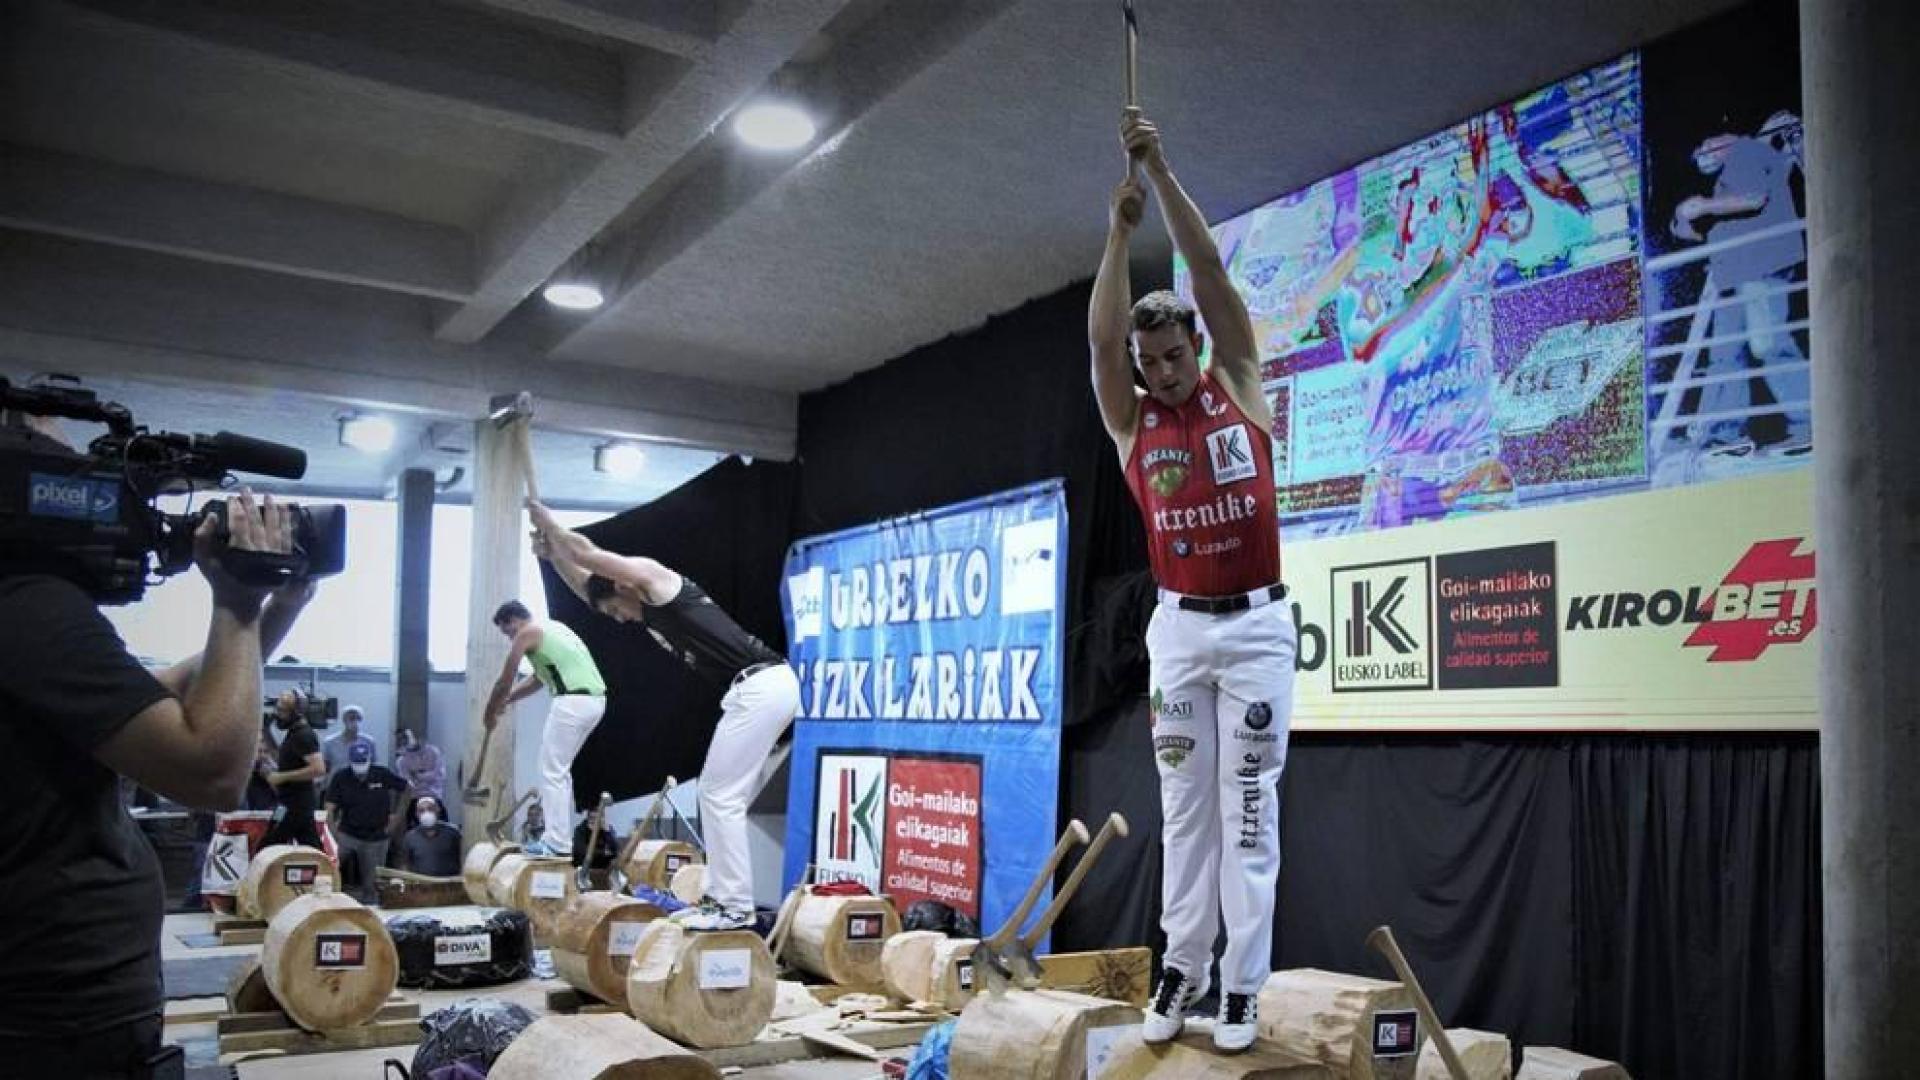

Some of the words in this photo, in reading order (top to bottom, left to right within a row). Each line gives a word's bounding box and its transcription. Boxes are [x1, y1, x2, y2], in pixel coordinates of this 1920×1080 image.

[33, 481, 88, 506] pixel
[1440, 570, 1551, 598] Goi-mailako
[1450, 597, 1542, 623] elikagaiak
[1455, 630, 1519, 648] Alimentos
[1522, 628, 1539, 645] de
[1338, 663, 1381, 681] EUSKO
[1385, 662, 1426, 680] LABEL
[1446, 649, 1492, 668] calidad
[1495, 648, 1549, 667] superior
[889, 784, 977, 817] Goi-mailako
[896, 816, 970, 848] elikagaiak
[898, 849, 950, 874] Alimentos
[951, 860, 966, 878] de
[888, 872, 928, 893] calidad
[930, 879, 973, 902] superior
